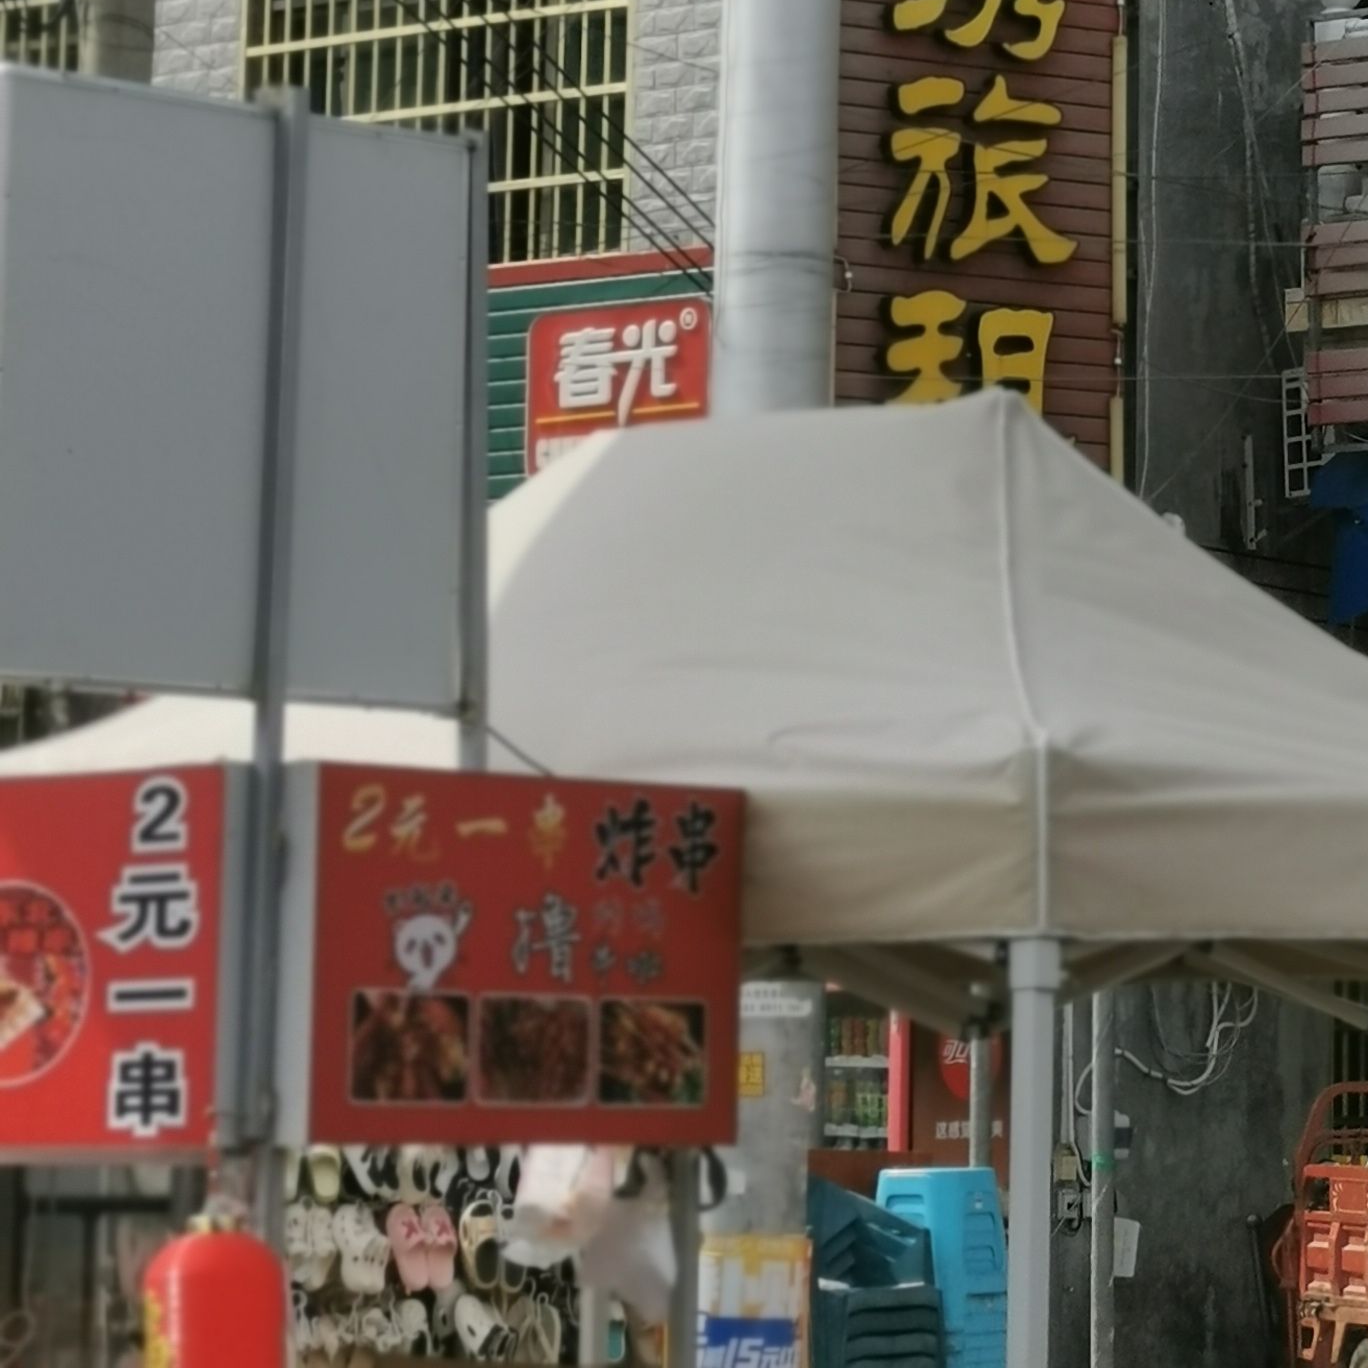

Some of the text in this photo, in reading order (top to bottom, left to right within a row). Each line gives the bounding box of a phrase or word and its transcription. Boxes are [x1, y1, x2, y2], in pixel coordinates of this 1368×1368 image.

[553, 319, 678, 428] 春光
[594, 798, 720, 894] 炸串
[107, 776, 198, 1136] 2元一串
